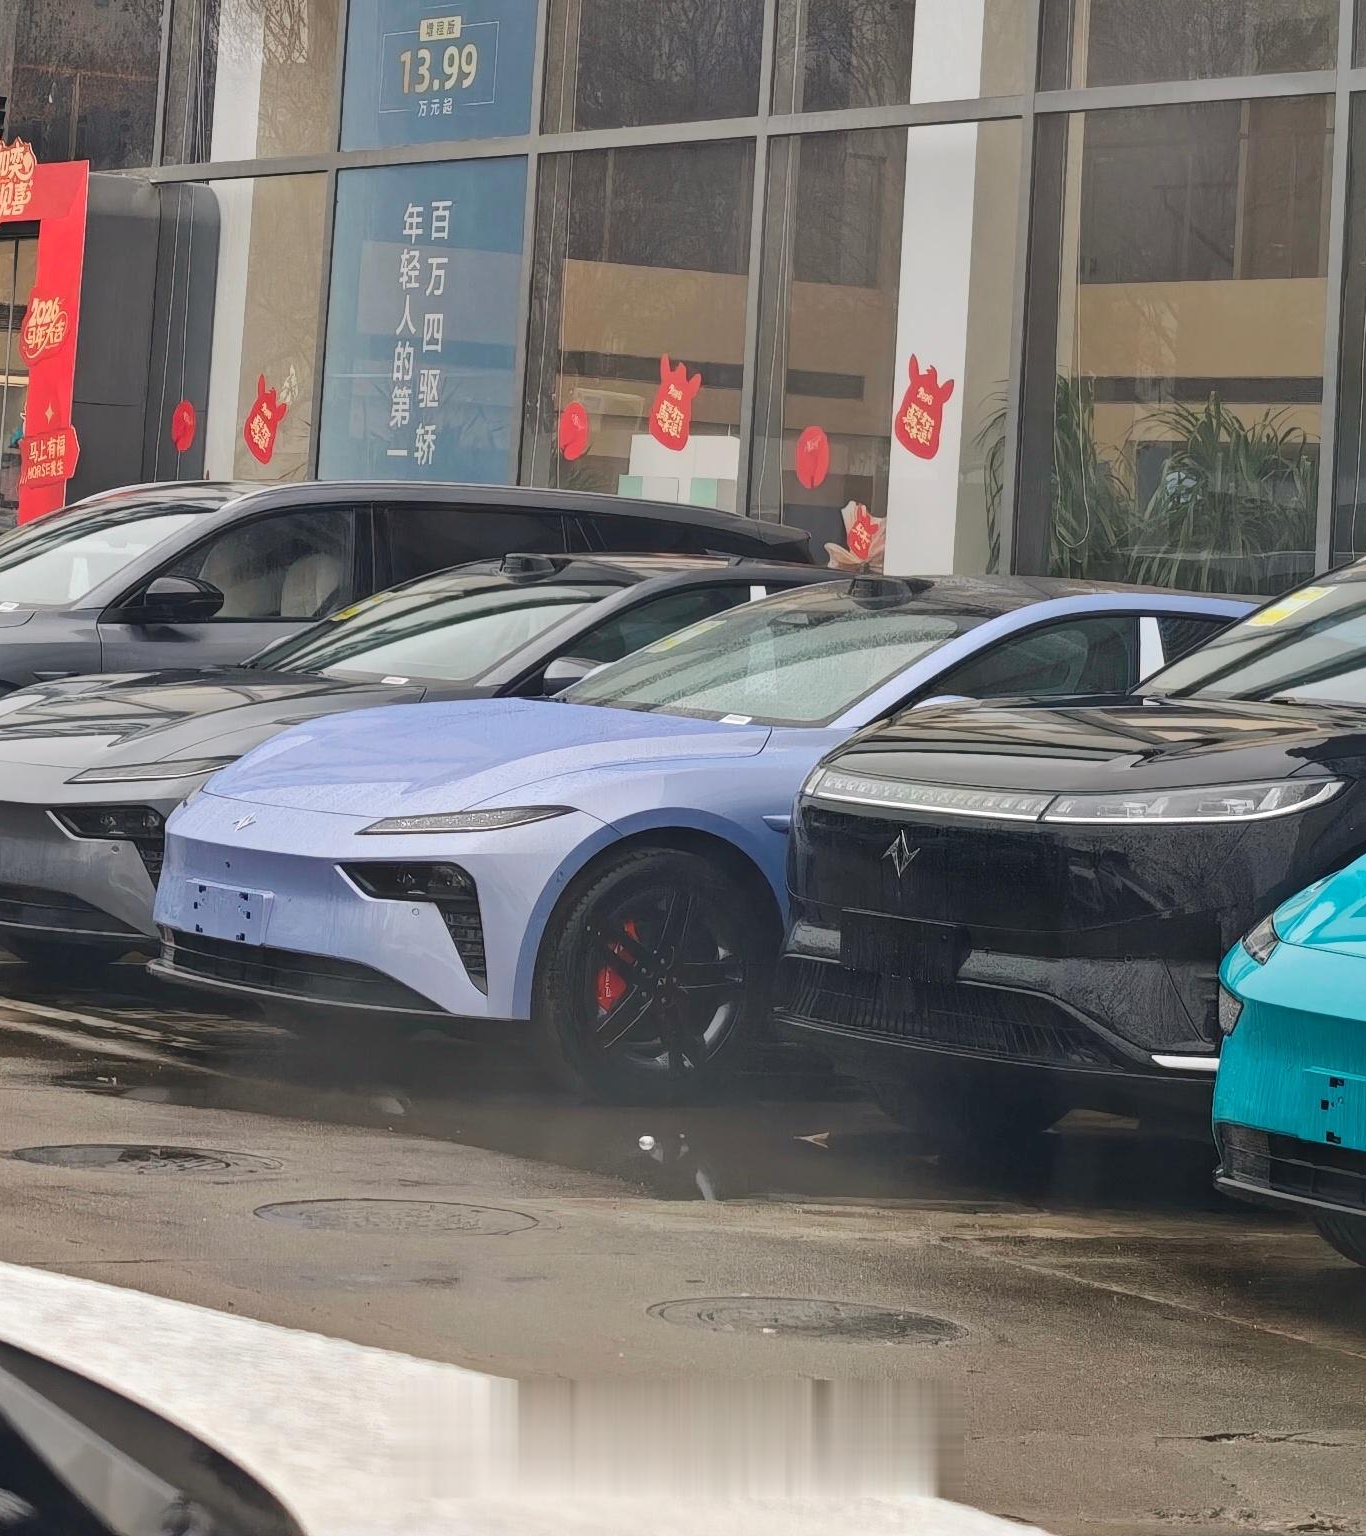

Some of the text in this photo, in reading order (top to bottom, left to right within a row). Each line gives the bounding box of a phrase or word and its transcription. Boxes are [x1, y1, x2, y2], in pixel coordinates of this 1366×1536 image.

[400, 44, 478, 95] 13.99
[418, 98, 453, 117] 万元起
[28, 297, 60, 326] 2026
[387, 202, 424, 458] 年轻人的第一
[414, 200, 453, 465] 百万四驱轿
[29, 434, 66, 464] 马上有福
